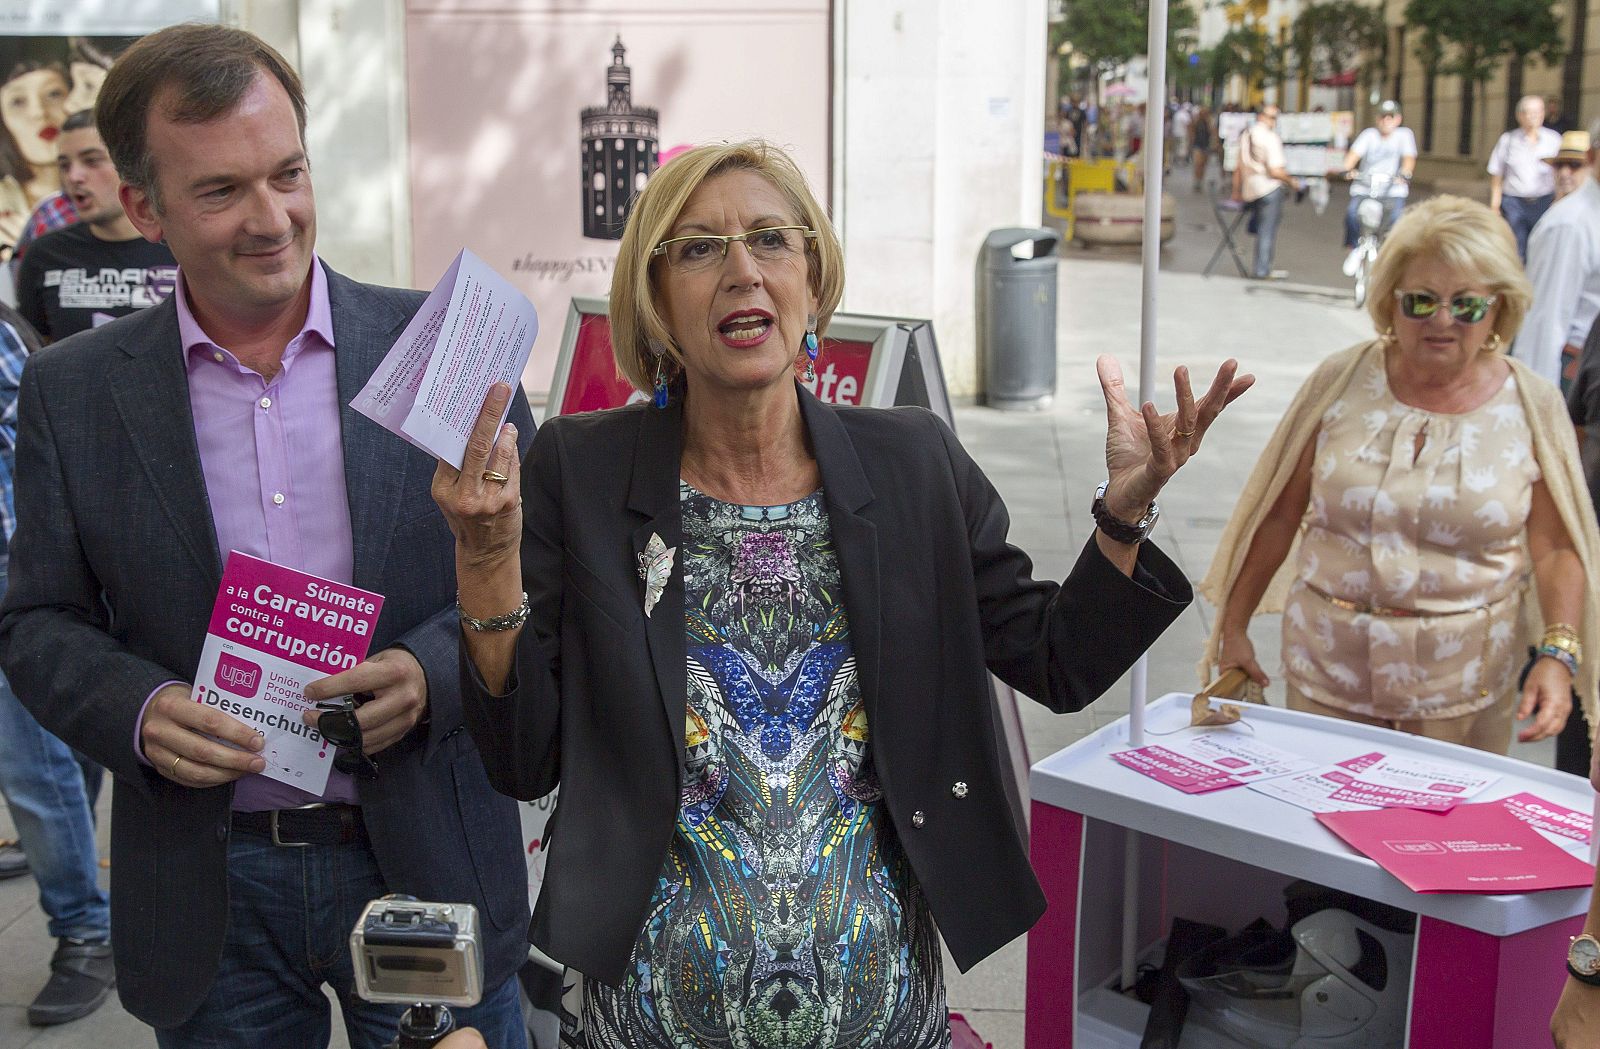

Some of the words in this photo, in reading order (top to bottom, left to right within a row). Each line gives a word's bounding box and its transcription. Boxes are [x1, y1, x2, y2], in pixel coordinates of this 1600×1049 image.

[226, 586, 235, 595] a
[237, 586, 249, 600] la
[253, 584, 369, 636] Caravana
[305, 581, 375, 615] Súmate
[230, 603, 270, 623] contra
[273, 614, 284, 628] la
[222, 642, 234, 651] con
[226, 616, 358, 670] corrupción
[270, 671, 301, 689] Unión
[264, 692, 310, 712] Democra
